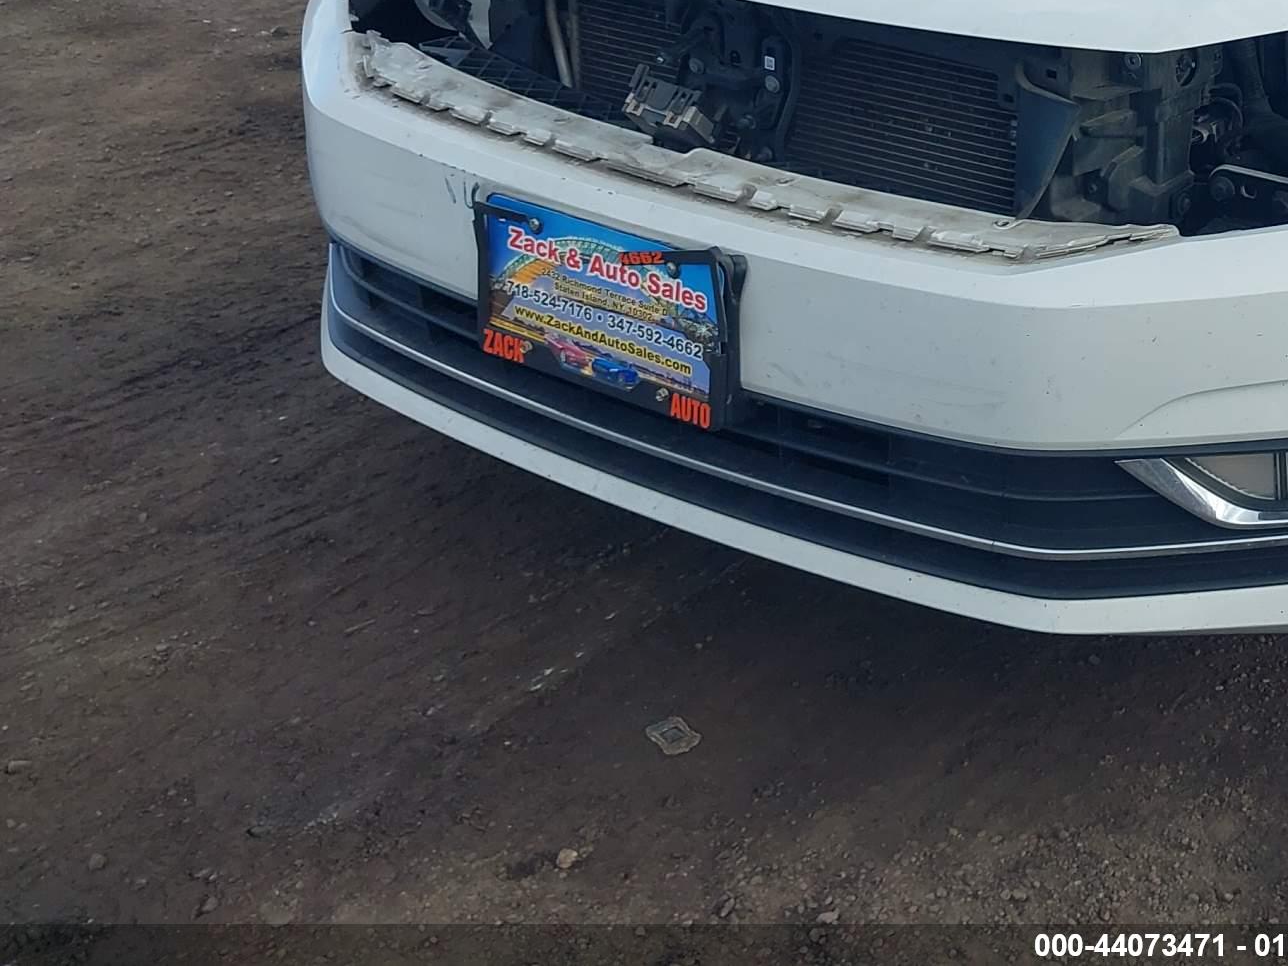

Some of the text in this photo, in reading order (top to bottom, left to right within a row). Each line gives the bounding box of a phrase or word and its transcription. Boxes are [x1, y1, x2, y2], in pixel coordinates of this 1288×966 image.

[507, 226, 708, 313] Zack & Auto Sales
[620, 250, 664, 265] 4662
[554, 281, 580, 297] Staten
[628, 307, 653, 322] 10302
[562, 275, 602, 293] Richmond
[605, 288, 638, 306] Terrace
[639, 299, 661, 315] Suite
[506, 280, 703, 359] 718-524-7176 347-592-4662
[514, 305, 692, 374] www.ZackAndAutoSales.com
[483, 328, 525, 364] ZACK
[670, 393, 712, 429] AUTO
